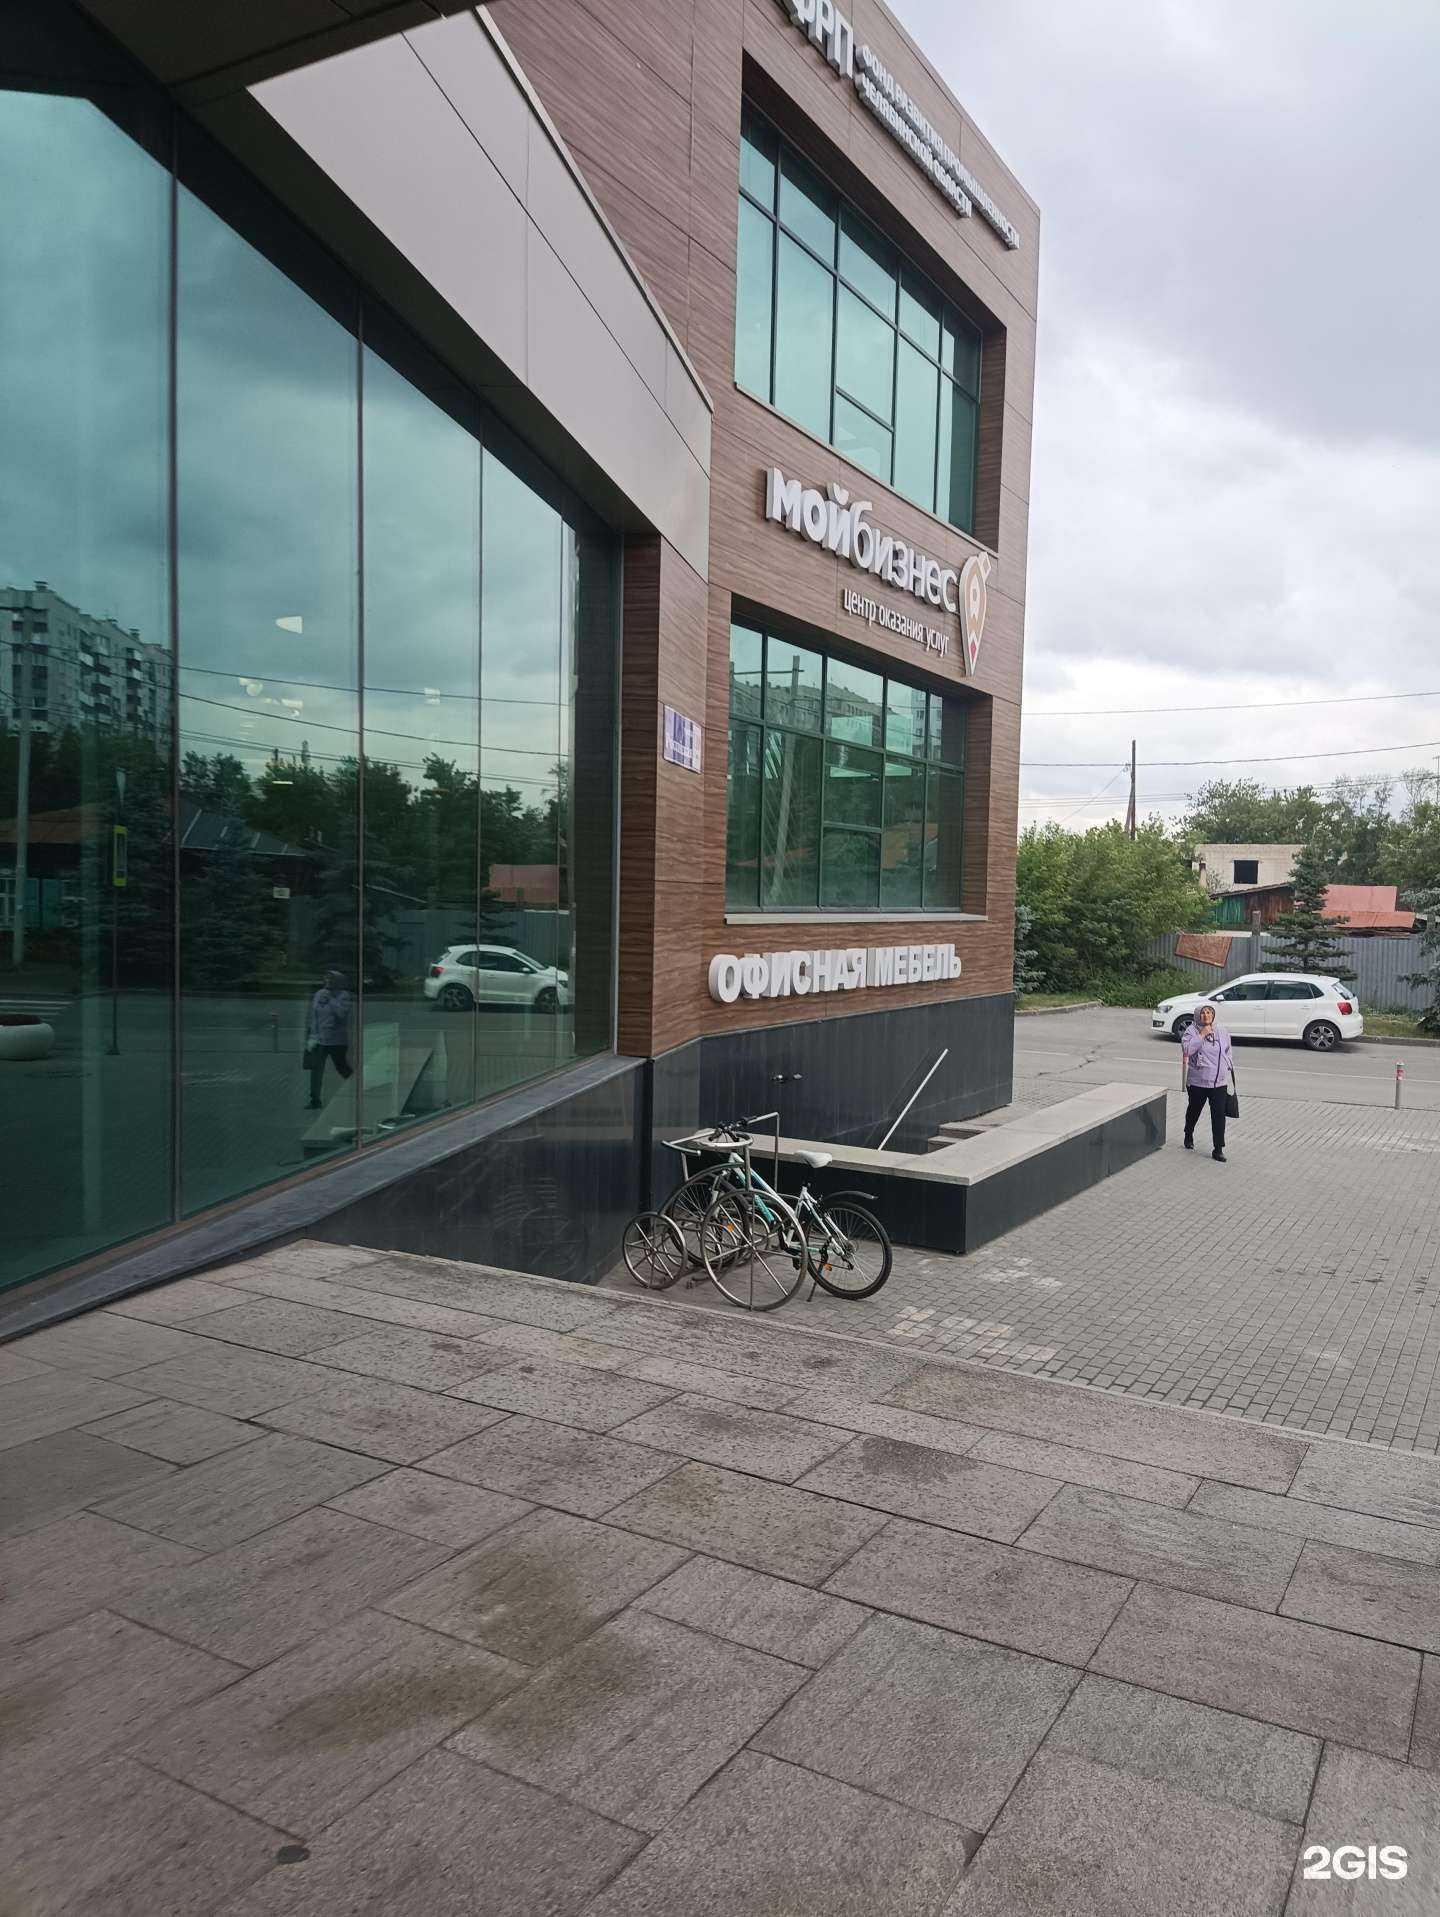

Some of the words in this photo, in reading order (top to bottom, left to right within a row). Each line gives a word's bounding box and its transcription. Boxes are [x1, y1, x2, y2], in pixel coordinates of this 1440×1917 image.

[860, 44, 895, 101] ФОНД
[895, 83, 943, 157] РАЗВИТИЯ
[860, 73, 933, 170] ЧЕЛЯБИНСКОЙ
[933, 158, 972, 218] ОБЛАСТИ
[843, 588, 876, 627] центр
[878, 606, 924, 644] оказания
[924, 627, 950, 658] услуг
[709, 948, 867, 1004] ОФИСНАЯ
[867, 943, 962, 987] МЕБЕЛЬ
